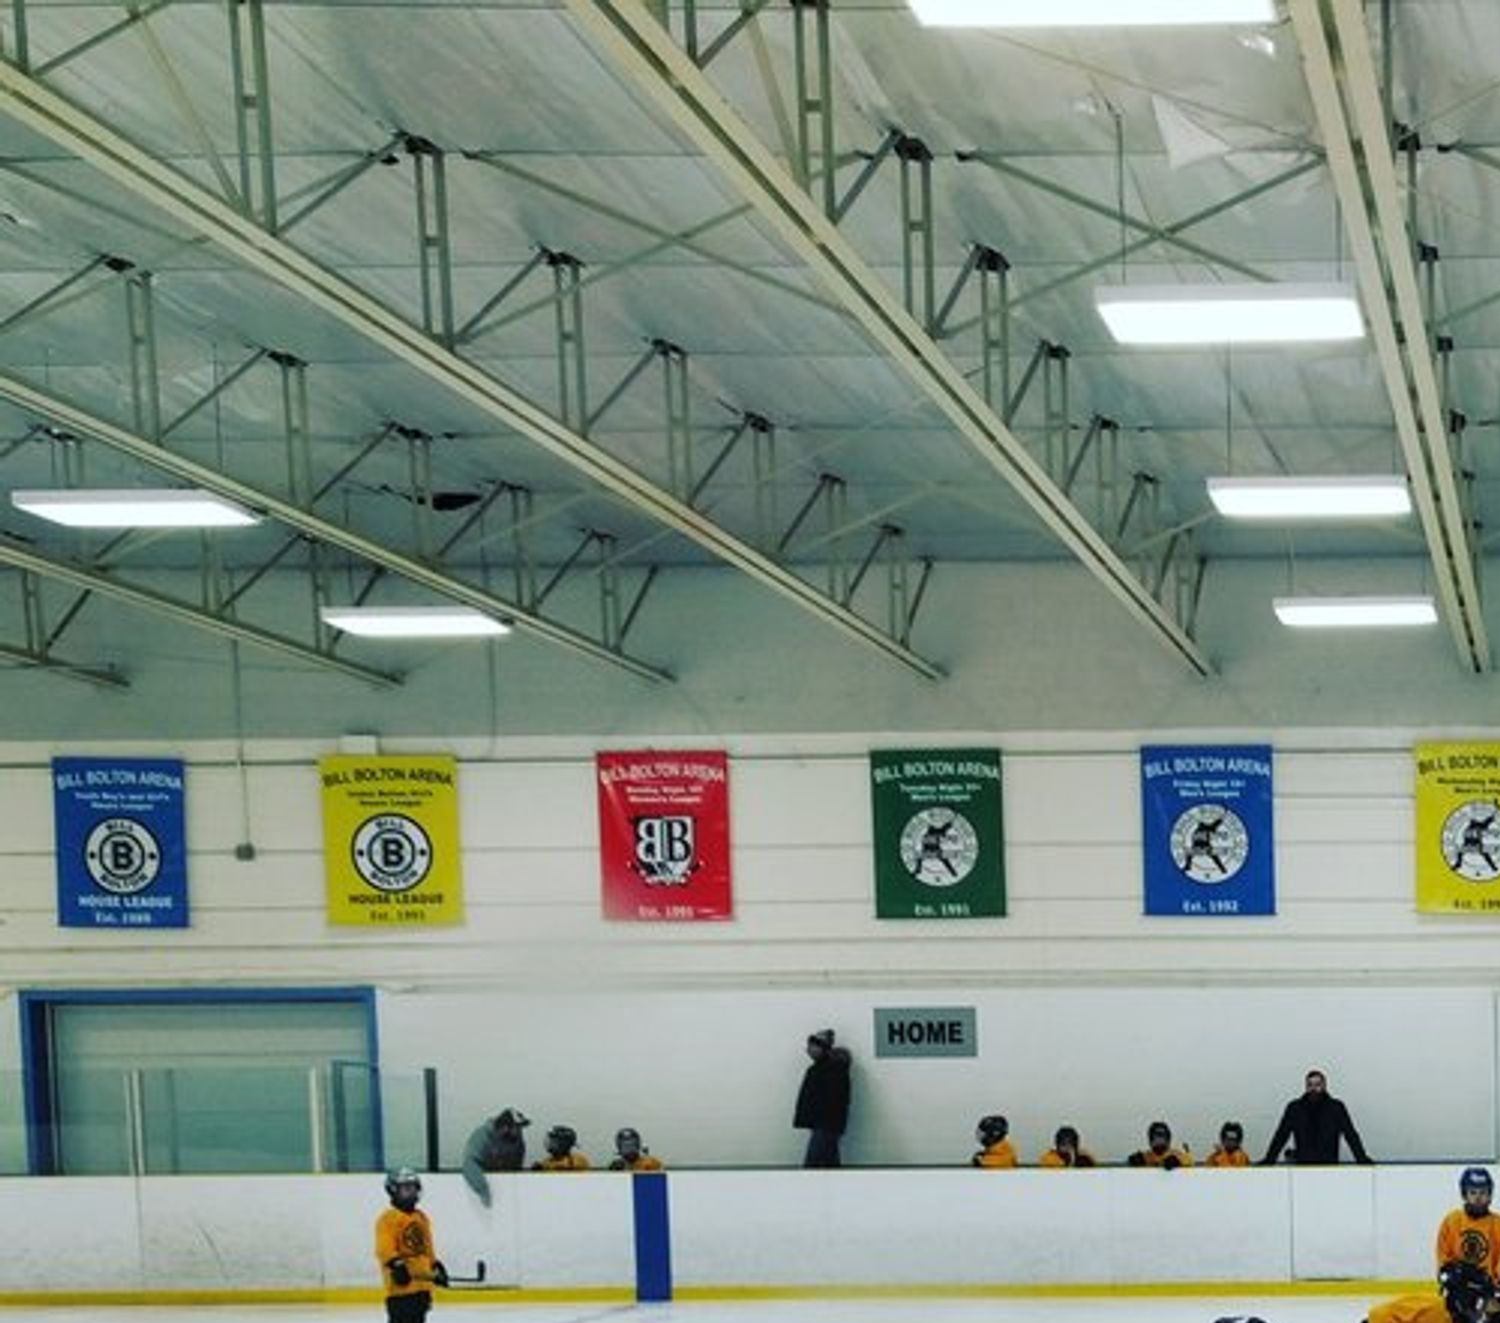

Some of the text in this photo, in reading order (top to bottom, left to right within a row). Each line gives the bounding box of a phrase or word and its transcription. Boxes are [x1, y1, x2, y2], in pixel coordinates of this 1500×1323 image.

[630, 764, 679, 781] BOLTON
[682, 764, 725, 782] ARENA
[874, 762, 999, 782] BILL BOLTON ARENA
[1146, 758, 1270, 779] BILL BOLTON ARENA
[1418, 759, 1445, 775] BILL
[1447, 755, 1498, 769] BOLTON
[57, 769, 182, 790] BILL BOLTON ARENA
[323, 768, 452, 787] BILL BOLTON ARENA
[111, 840, 134, 870] B
[382, 839, 404, 867] B
[78, 895, 172, 908] HOUSE LEAGUE
[348, 894, 443, 904] HOUSE LEAGUE
[887, 1020, 964, 1045] HOME
